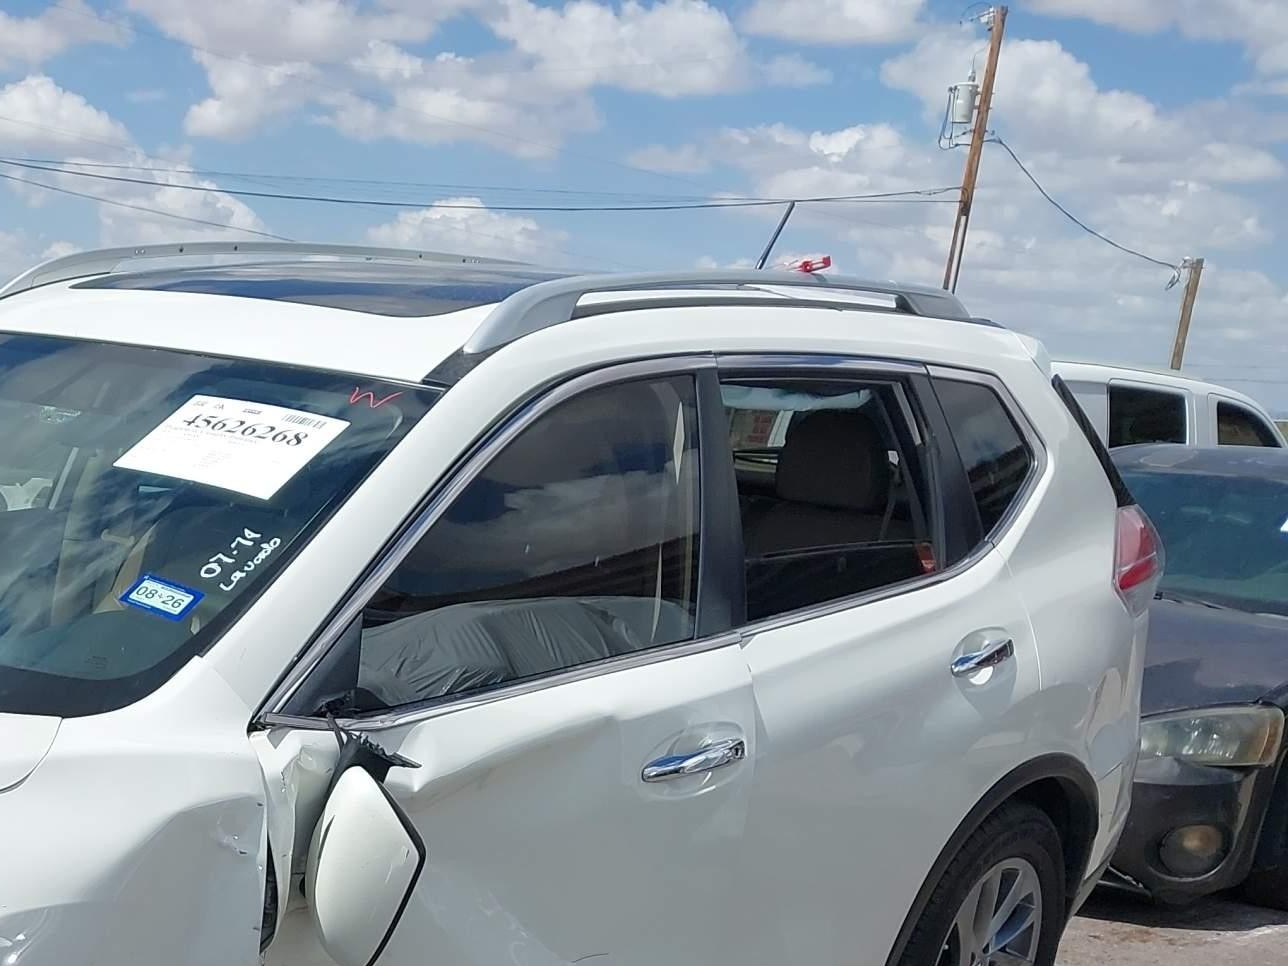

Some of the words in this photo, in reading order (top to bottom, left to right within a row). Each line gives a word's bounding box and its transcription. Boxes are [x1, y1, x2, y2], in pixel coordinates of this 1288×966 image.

[183, 413, 309, 447] 45626268
[135, 585, 155, 600] 08
[161, 594, 185, 610] 26
